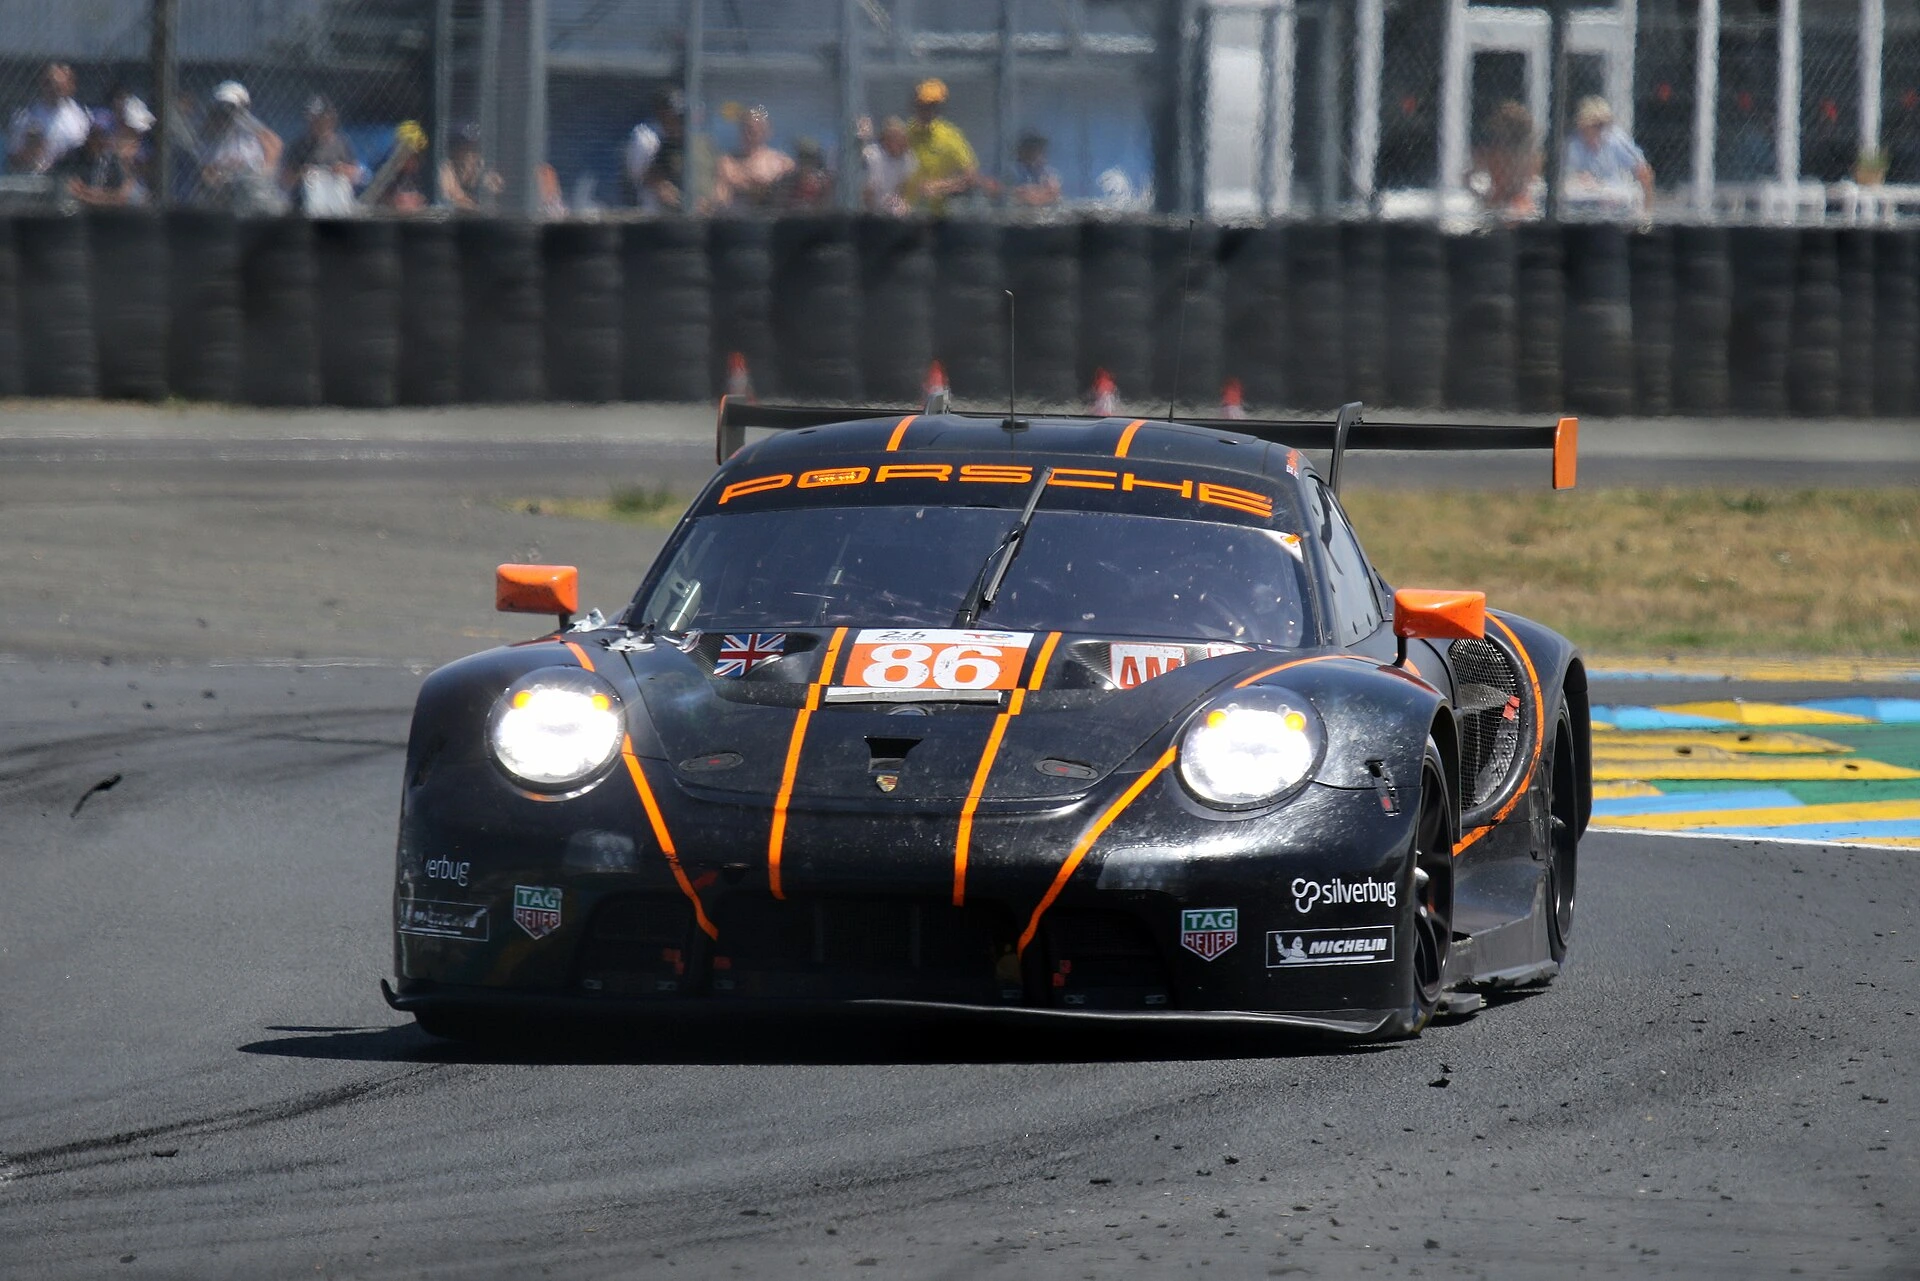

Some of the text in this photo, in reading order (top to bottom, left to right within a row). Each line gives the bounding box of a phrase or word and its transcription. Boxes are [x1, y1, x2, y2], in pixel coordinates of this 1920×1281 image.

[718, 463, 1273, 518] PORSCHE
[862, 643, 1003, 690] 86
[518, 889, 557, 909] TAG
[1322, 876, 1397, 908] silverbug
[516, 909, 559, 933] HEUER
[1186, 912, 1233, 930] TAG
[1184, 932, 1235, 957] HEUER
[1308, 938, 1388, 955] MICHELIN
